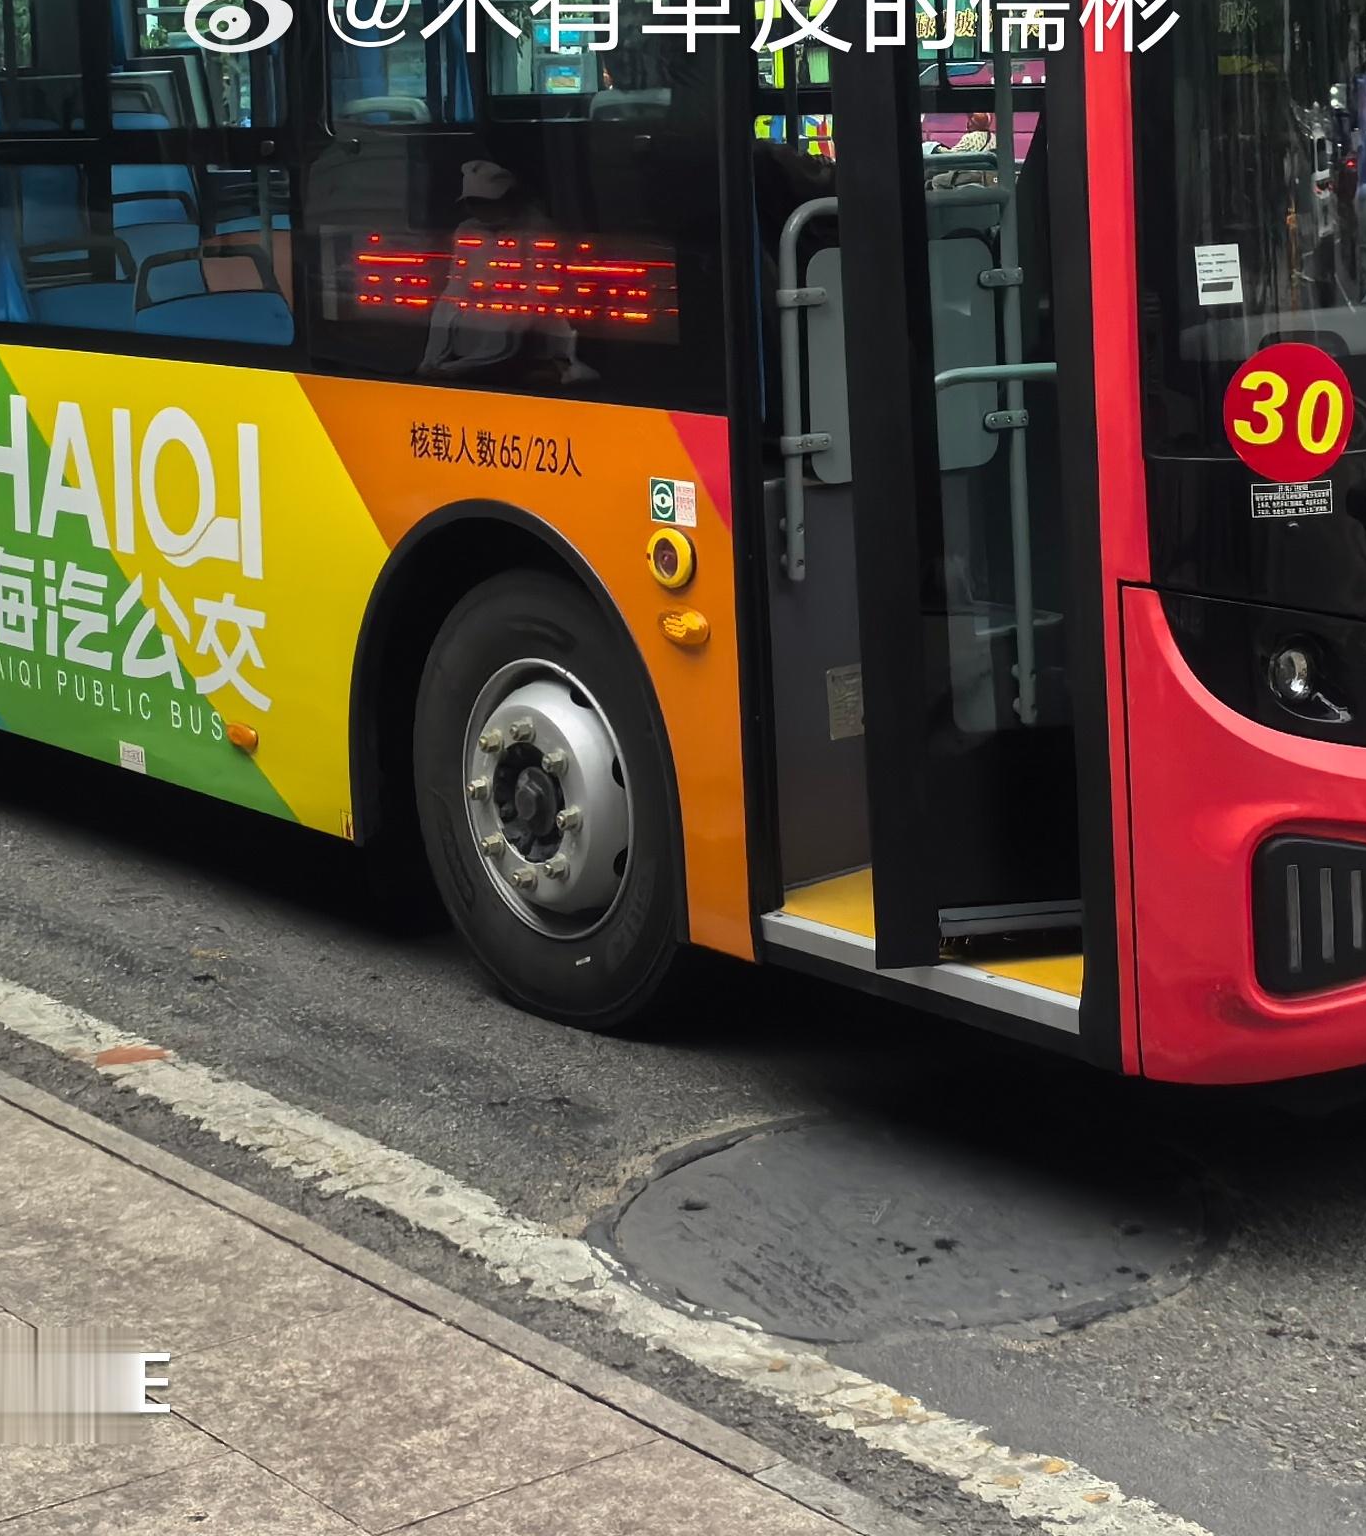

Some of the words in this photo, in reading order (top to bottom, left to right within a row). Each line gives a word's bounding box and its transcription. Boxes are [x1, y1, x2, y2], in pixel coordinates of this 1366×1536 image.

[1233, 370, 1344, 454] 30
[409, 420, 582, 478] 核载人数65/23人
[57, 670, 152, 720] PUBLIC
[170, 700, 223, 741] BUS
